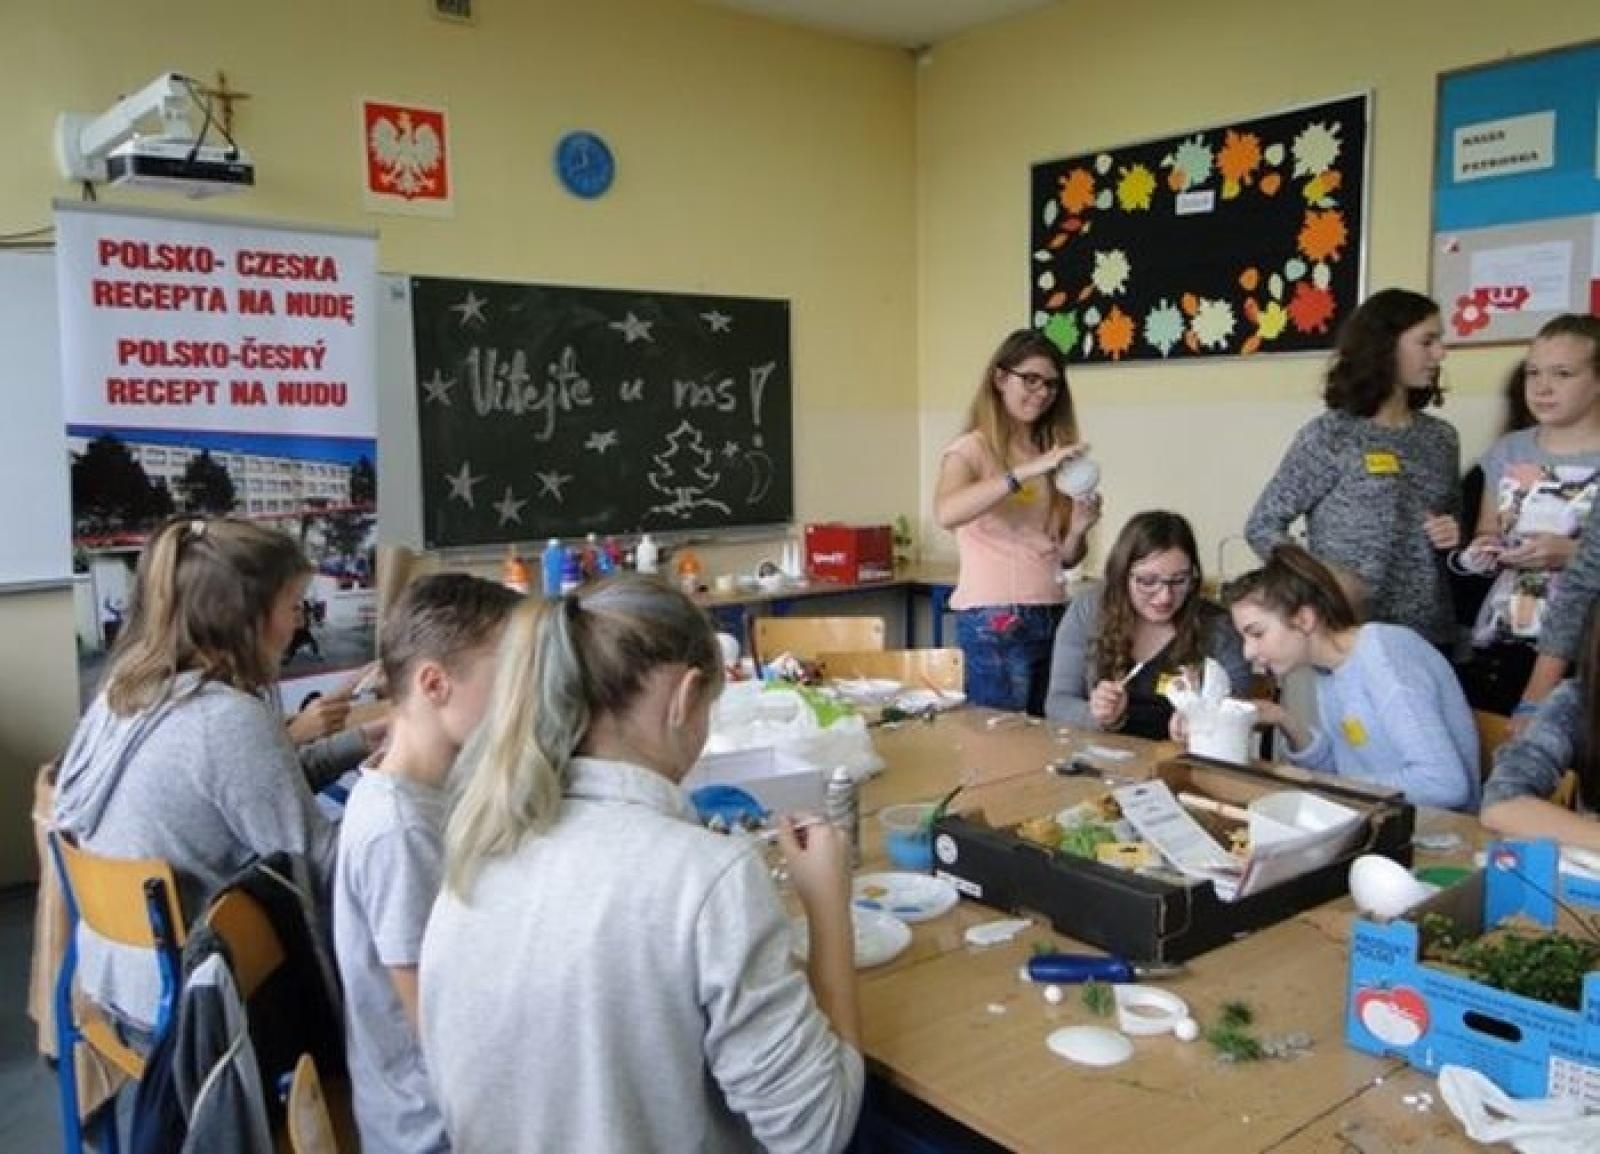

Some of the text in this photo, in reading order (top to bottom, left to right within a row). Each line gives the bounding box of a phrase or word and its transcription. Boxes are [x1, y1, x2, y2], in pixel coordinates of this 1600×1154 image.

[98, 239, 338, 282] POLSKO- CZESKA
[93, 280, 355, 325] RECEPTA NA NUDĘ
[118, 338, 327, 371] POLSKO-ČESKÝ
[107, 377, 348, 408] RECEPT NA NUDU
[620, 378, 643, 401] u
